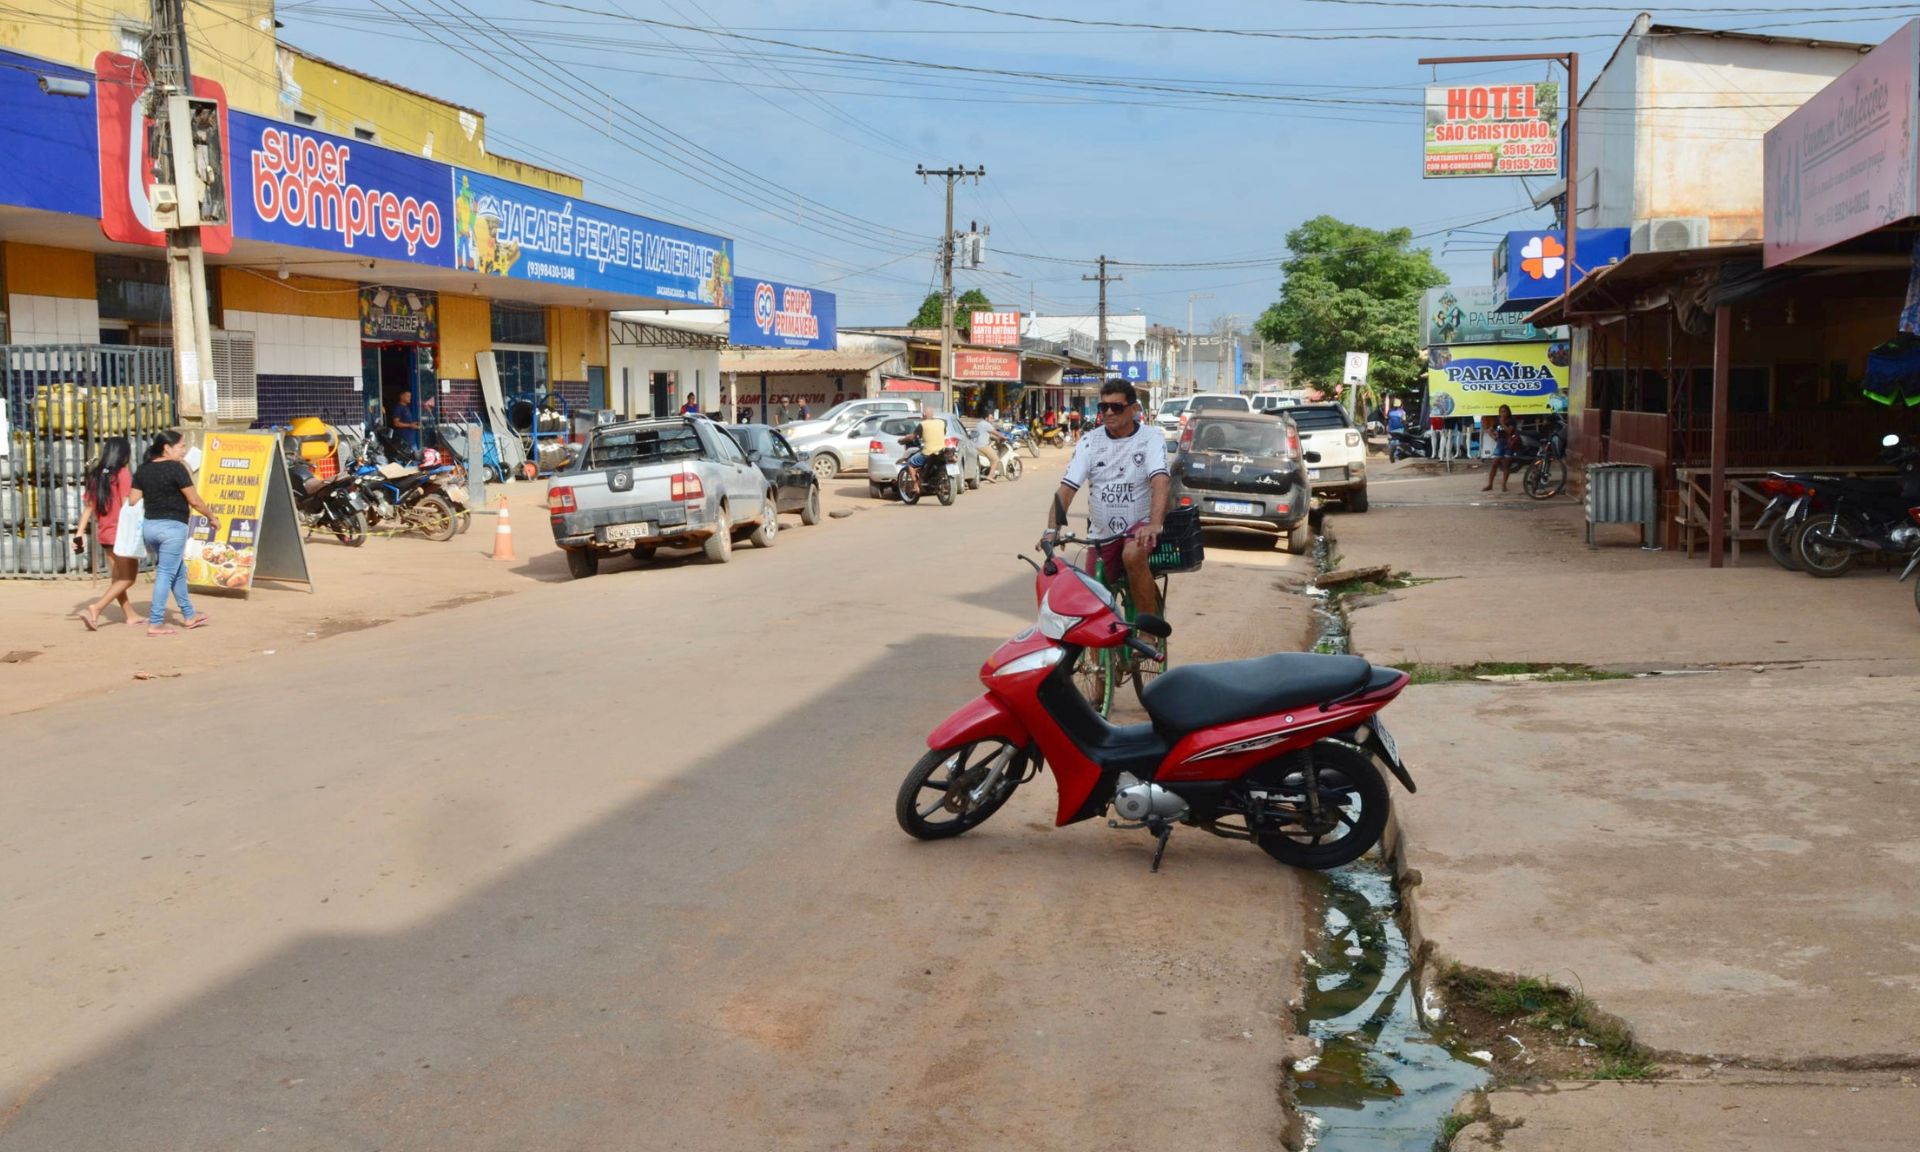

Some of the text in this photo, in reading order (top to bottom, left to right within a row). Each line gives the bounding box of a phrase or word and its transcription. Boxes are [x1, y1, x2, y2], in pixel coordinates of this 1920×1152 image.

[1447, 86, 1538, 119] HOTEL
[1436, 120, 1548, 141] SÃO CRISTOVÃO
[262, 127, 350, 188] super
[1503, 143, 1553, 155] 3518-1220
[1500, 159, 1556, 170] 99139-2051
[252, 149, 442, 256] bompreço
[496, 201, 715, 280] JACARÉ PEÇAS E MATERIAIS
[784, 287, 811, 315] GRUPO
[379, 311, 417, 333] JACARÉ
[775, 311, 818, 339] PRIMAVERA
[975, 312, 1016, 324] HOTEL
[973, 325, 991, 334] SANTO
[1447, 361, 1553, 381] PARAÍBA
[1462, 380, 1541, 393] CONFECÇÕES
[1101, 493, 1136, 503] ROYAL
[1103, 483, 1135, 493] AZEITE
[206, 504, 226, 515] ANCHE
